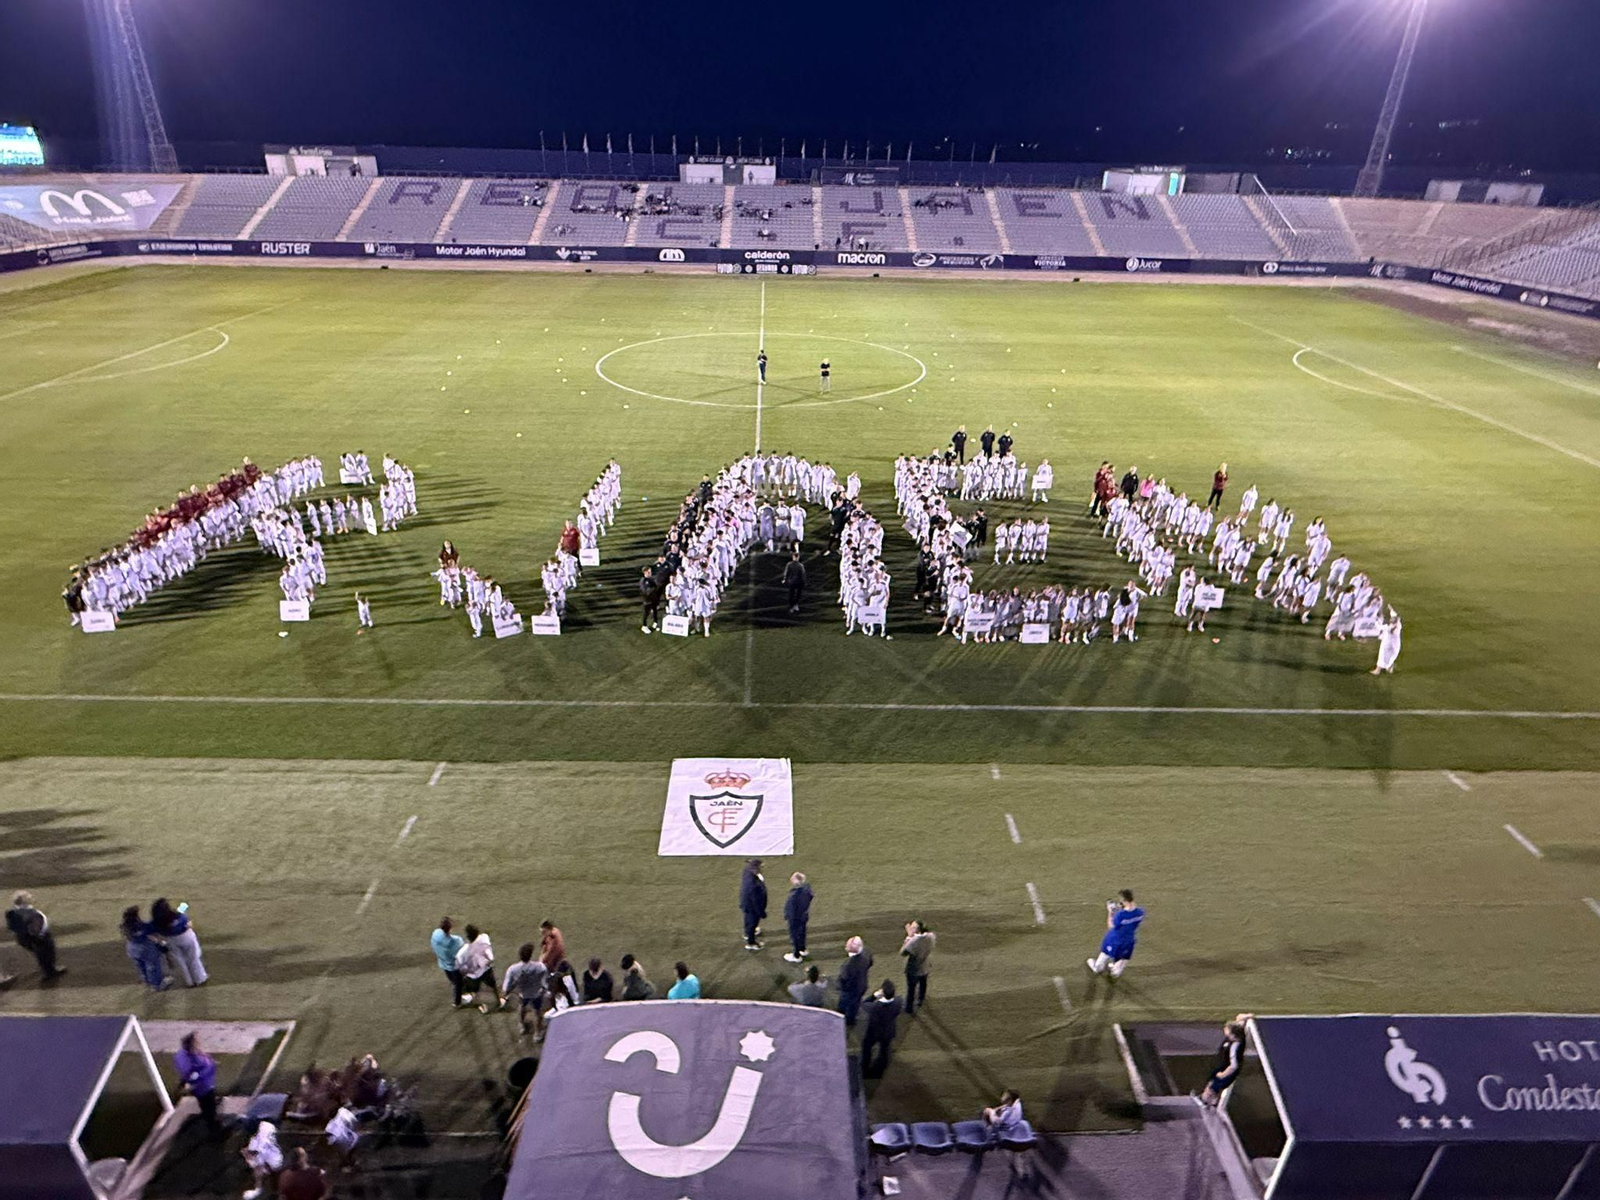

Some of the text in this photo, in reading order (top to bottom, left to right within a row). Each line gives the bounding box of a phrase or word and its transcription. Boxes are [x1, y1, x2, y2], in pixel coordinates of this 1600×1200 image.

[261, 242, 310, 254] RUSTER
[435, 245, 526, 258] Motor Jaén Hyundai
[744, 251, 791, 260] calderón
[837, 253, 886, 264] macron
[1431, 271, 1452, 284] Motor
